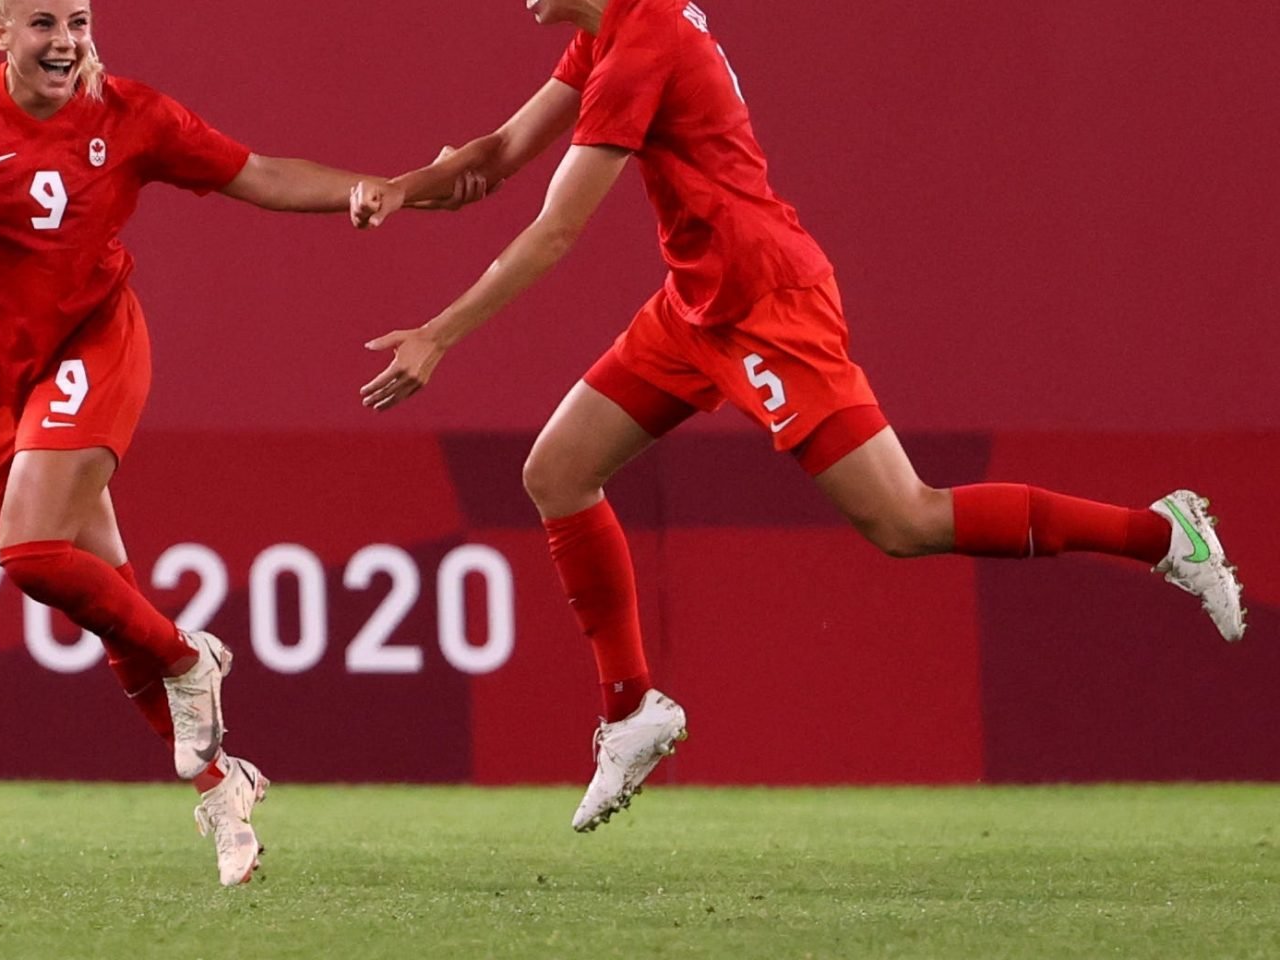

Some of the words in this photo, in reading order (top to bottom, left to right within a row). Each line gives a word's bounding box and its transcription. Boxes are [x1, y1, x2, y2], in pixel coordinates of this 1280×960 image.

[29, 170, 68, 230] 9
[49, 359, 89, 416] 9
[742, 352, 787, 413] 5
[151, 542, 516, 673] 2020
